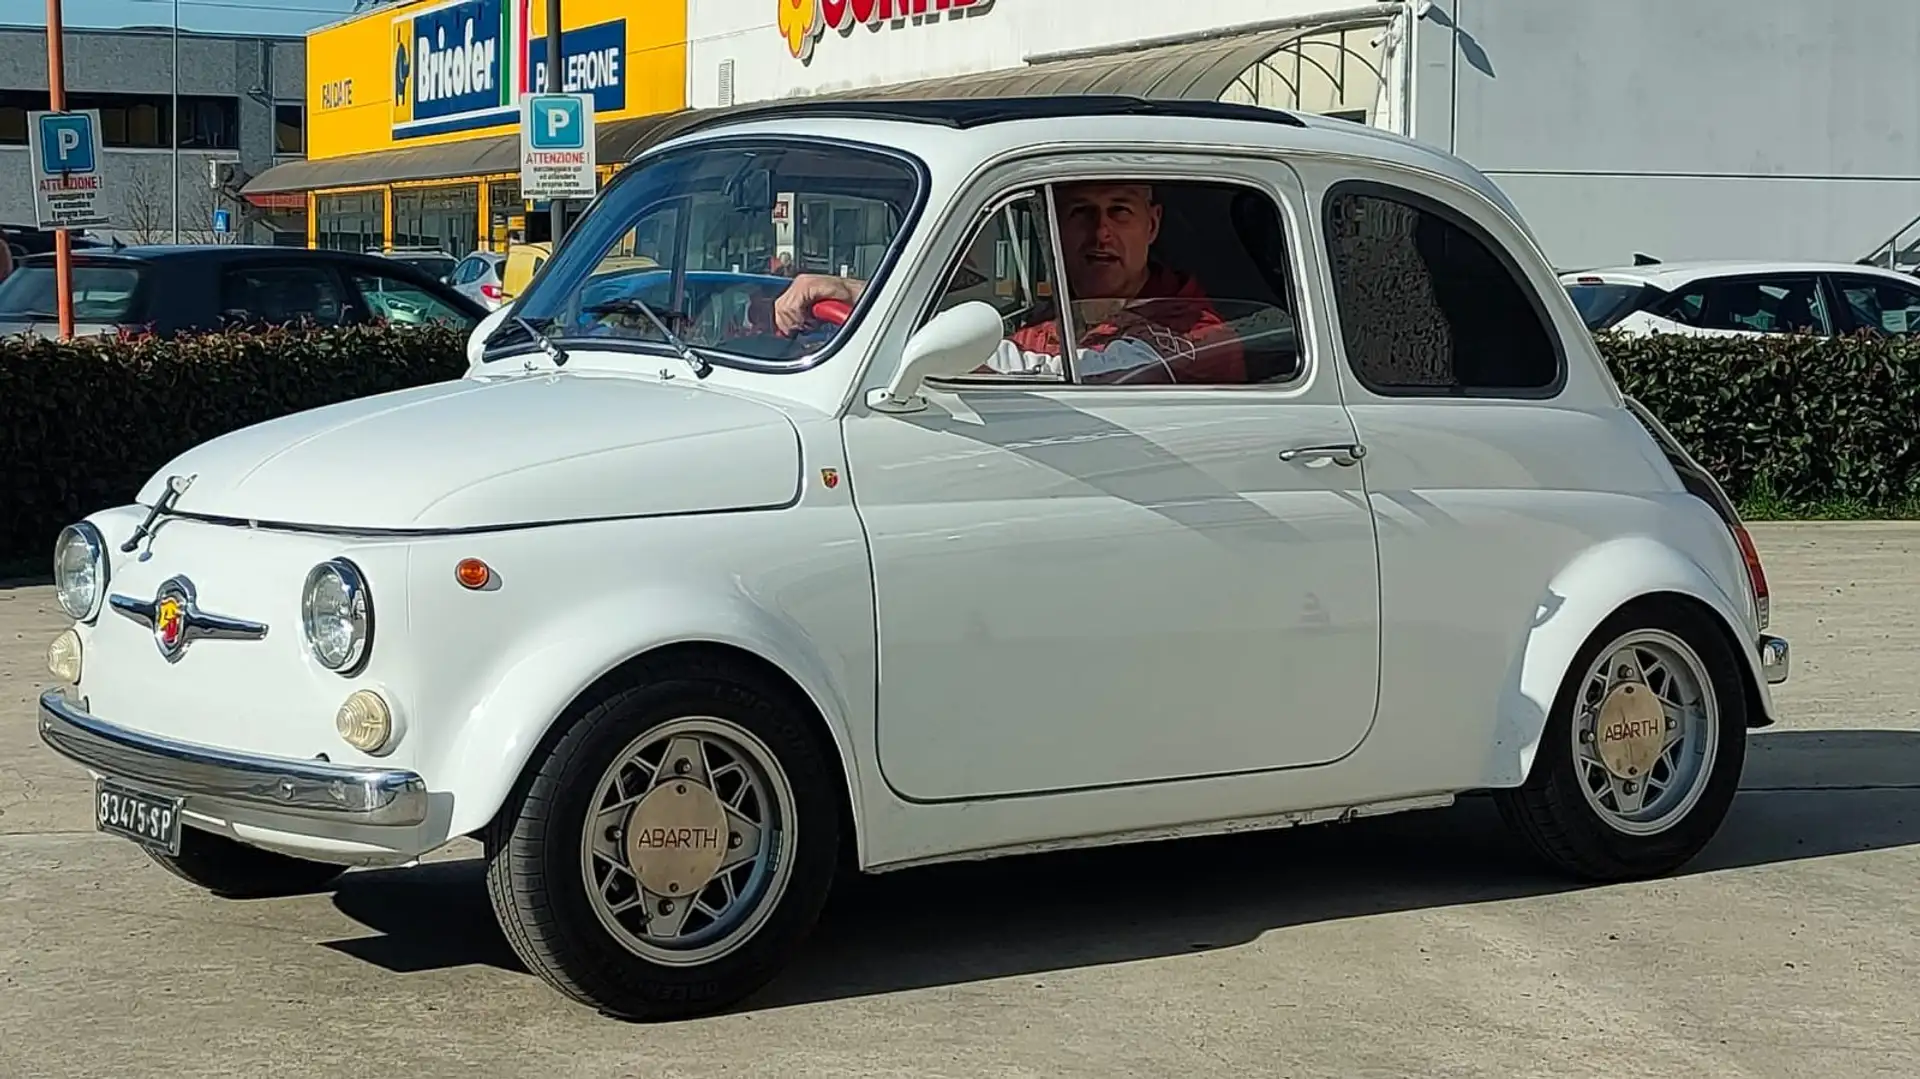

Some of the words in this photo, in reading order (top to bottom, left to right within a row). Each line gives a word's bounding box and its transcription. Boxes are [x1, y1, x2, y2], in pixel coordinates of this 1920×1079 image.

[418, 18, 495, 102] Bricofer
[535, 47, 619, 94] PLERONE
[547, 108, 570, 138] P
[57, 128, 79, 160] P
[525, 152, 585, 165] ATTENZIONE
[40, 176, 97, 191] ATTEZIONE
[1605, 718, 1659, 743] ABARTH
[638, 827, 718, 849] ABARTH
